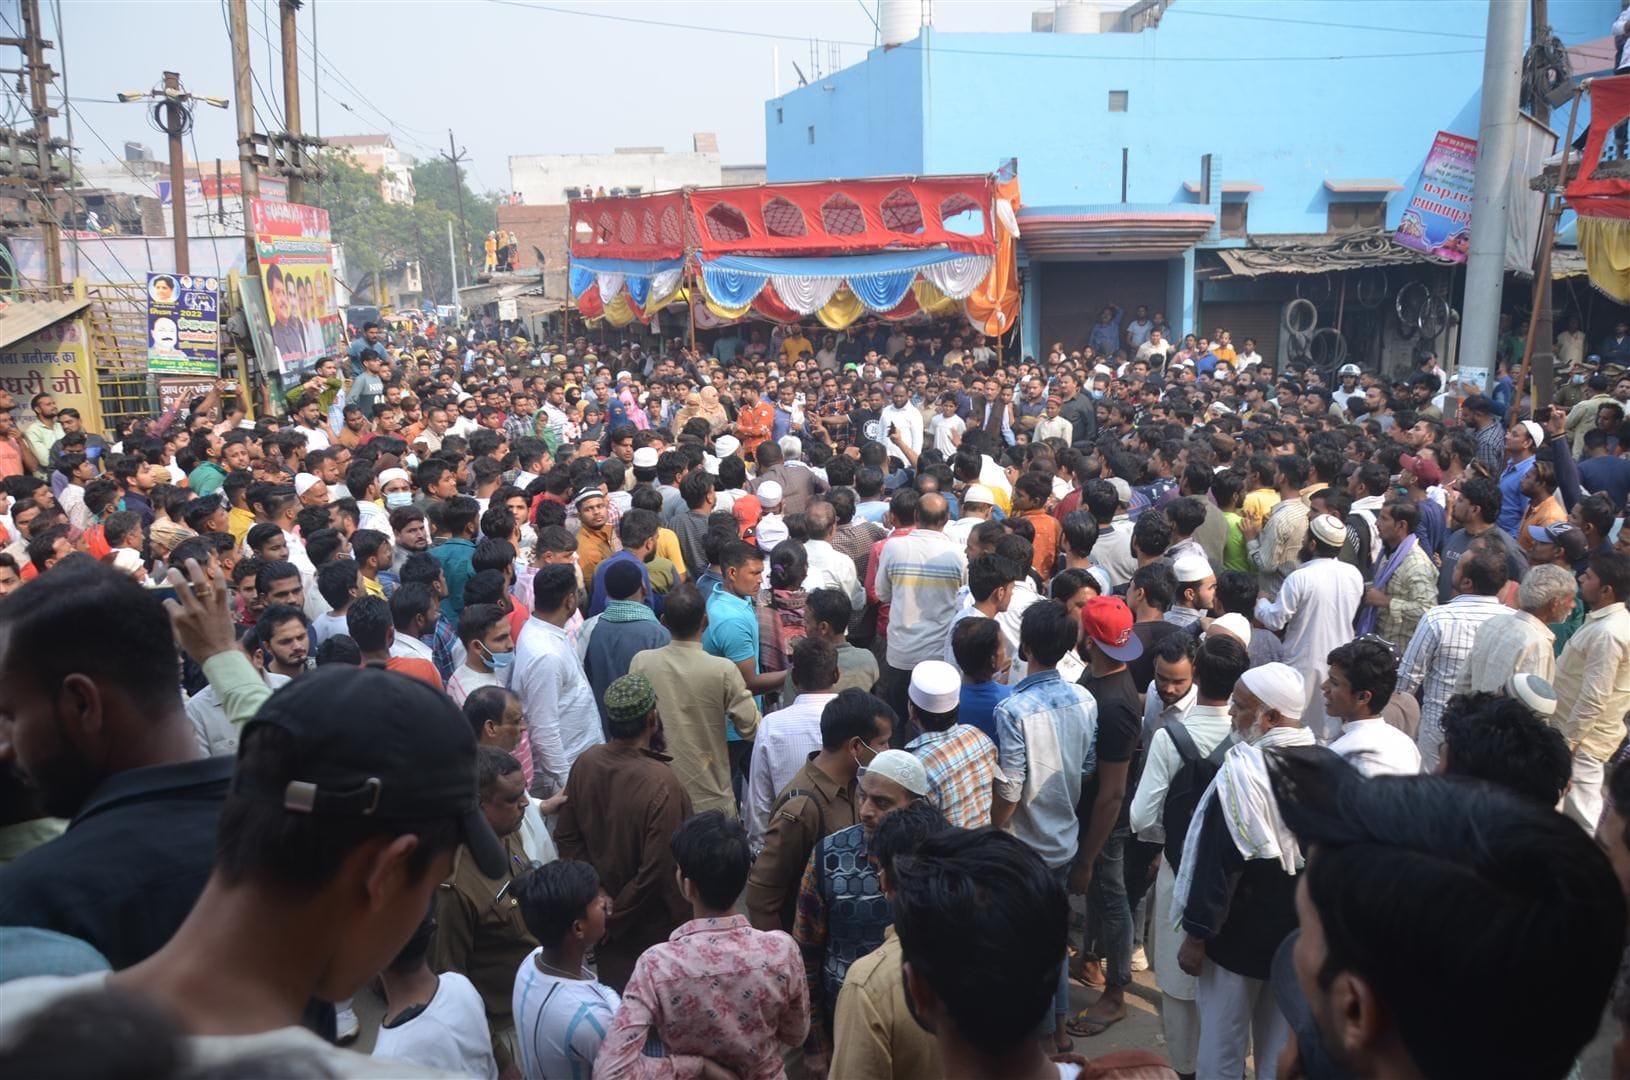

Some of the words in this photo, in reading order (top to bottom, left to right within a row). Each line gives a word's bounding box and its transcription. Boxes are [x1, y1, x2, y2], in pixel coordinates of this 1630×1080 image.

[1423, 183, 1473, 202] arden
[180, 309, 203, 318] 2022
[62, 351, 77, 363] का
[50, 369, 82, 394] जी
